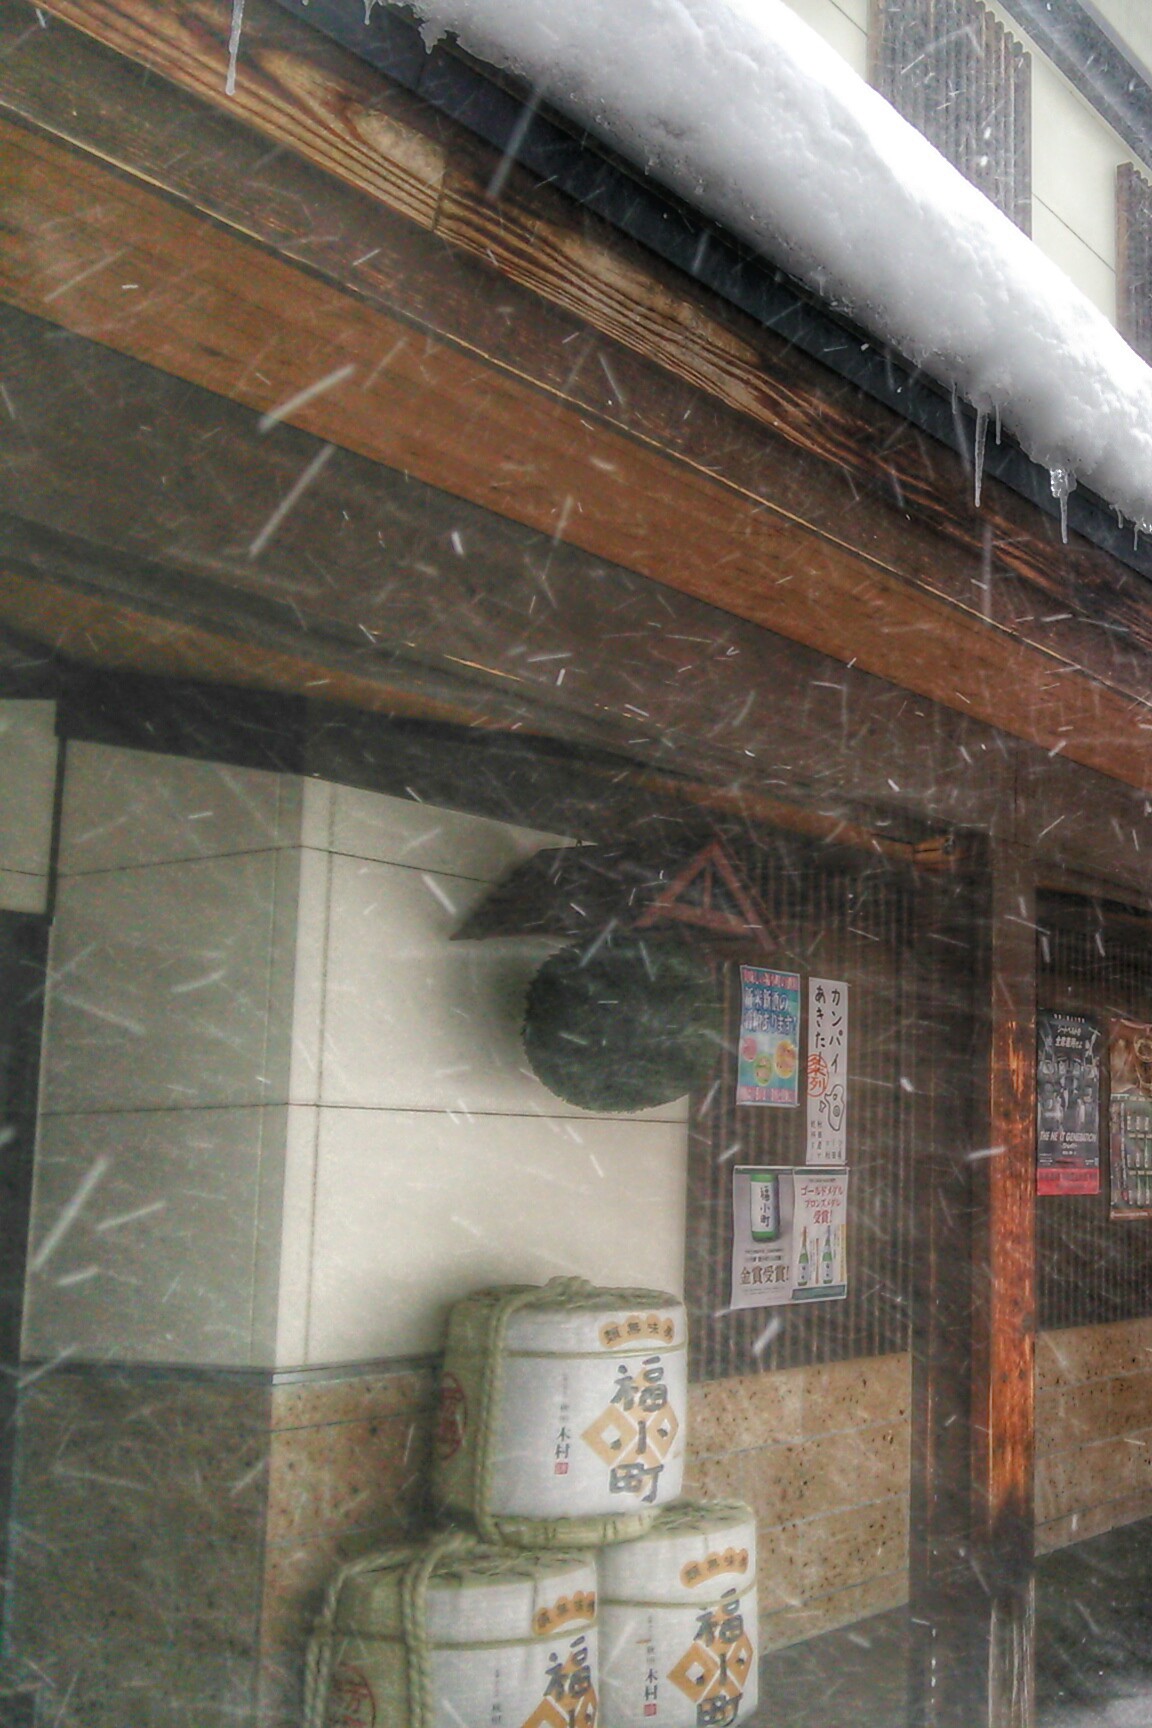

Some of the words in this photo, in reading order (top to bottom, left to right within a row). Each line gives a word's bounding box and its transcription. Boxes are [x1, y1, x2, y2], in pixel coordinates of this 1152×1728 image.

[829, 988, 843, 1074] カンパイ
[800, 1184, 845, 1199] ゴールドメダル
[739, 1265, 790, 1286] 金賞受賞!
[609, 1355, 669, 1505] 福小町
